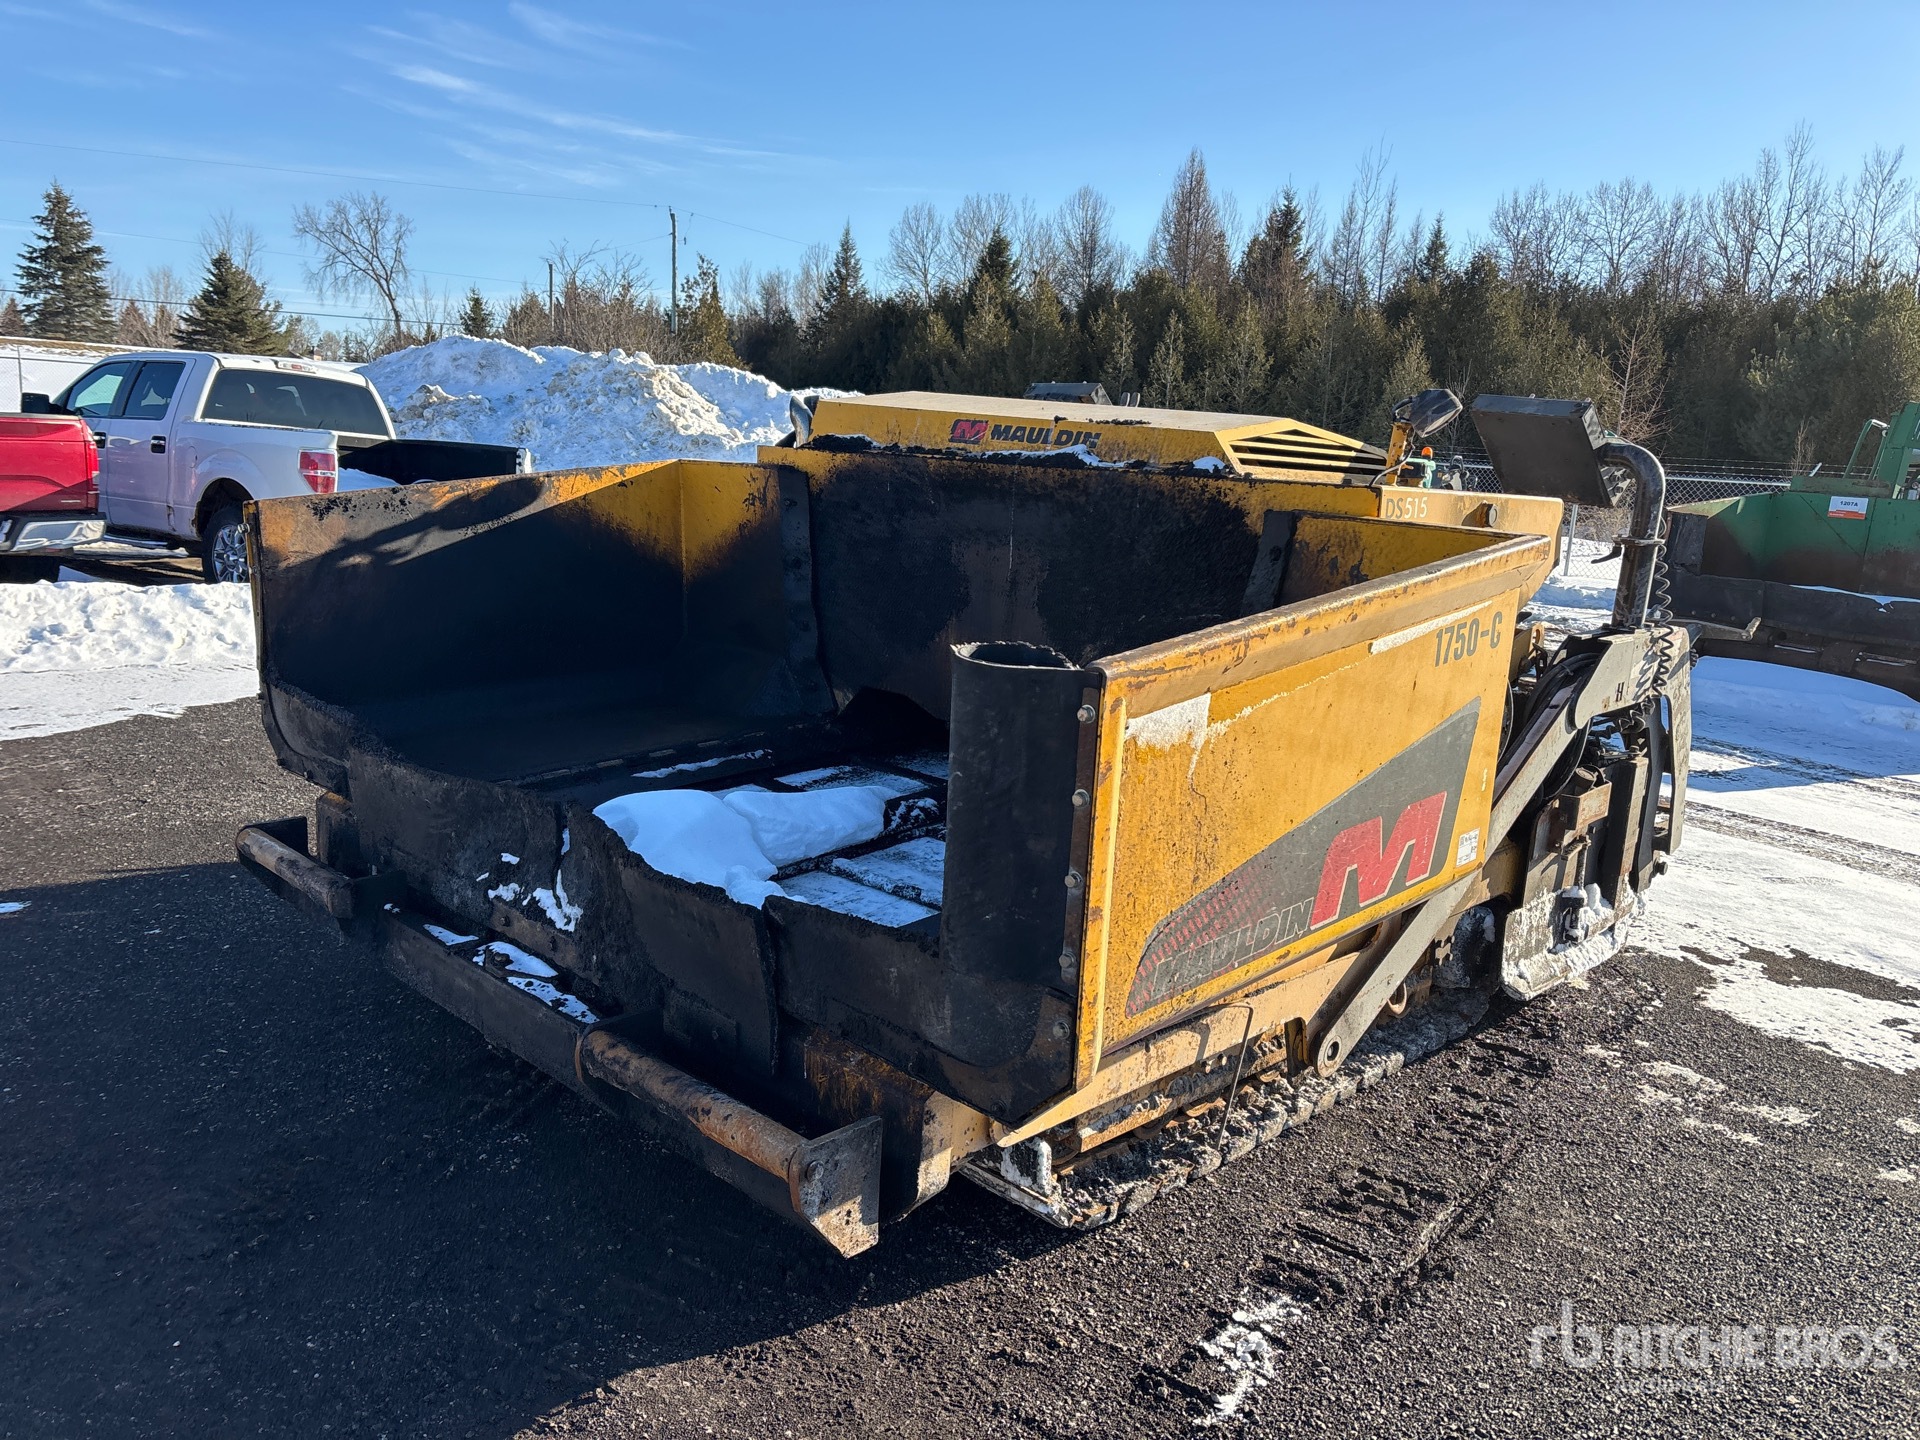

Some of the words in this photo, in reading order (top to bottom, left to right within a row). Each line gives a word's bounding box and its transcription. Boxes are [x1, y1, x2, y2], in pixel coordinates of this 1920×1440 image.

[990, 424, 1102, 449] MAULDIN
[1385, 496, 1428, 519] DS515
[1434, 610, 1503, 668] 1750-C
